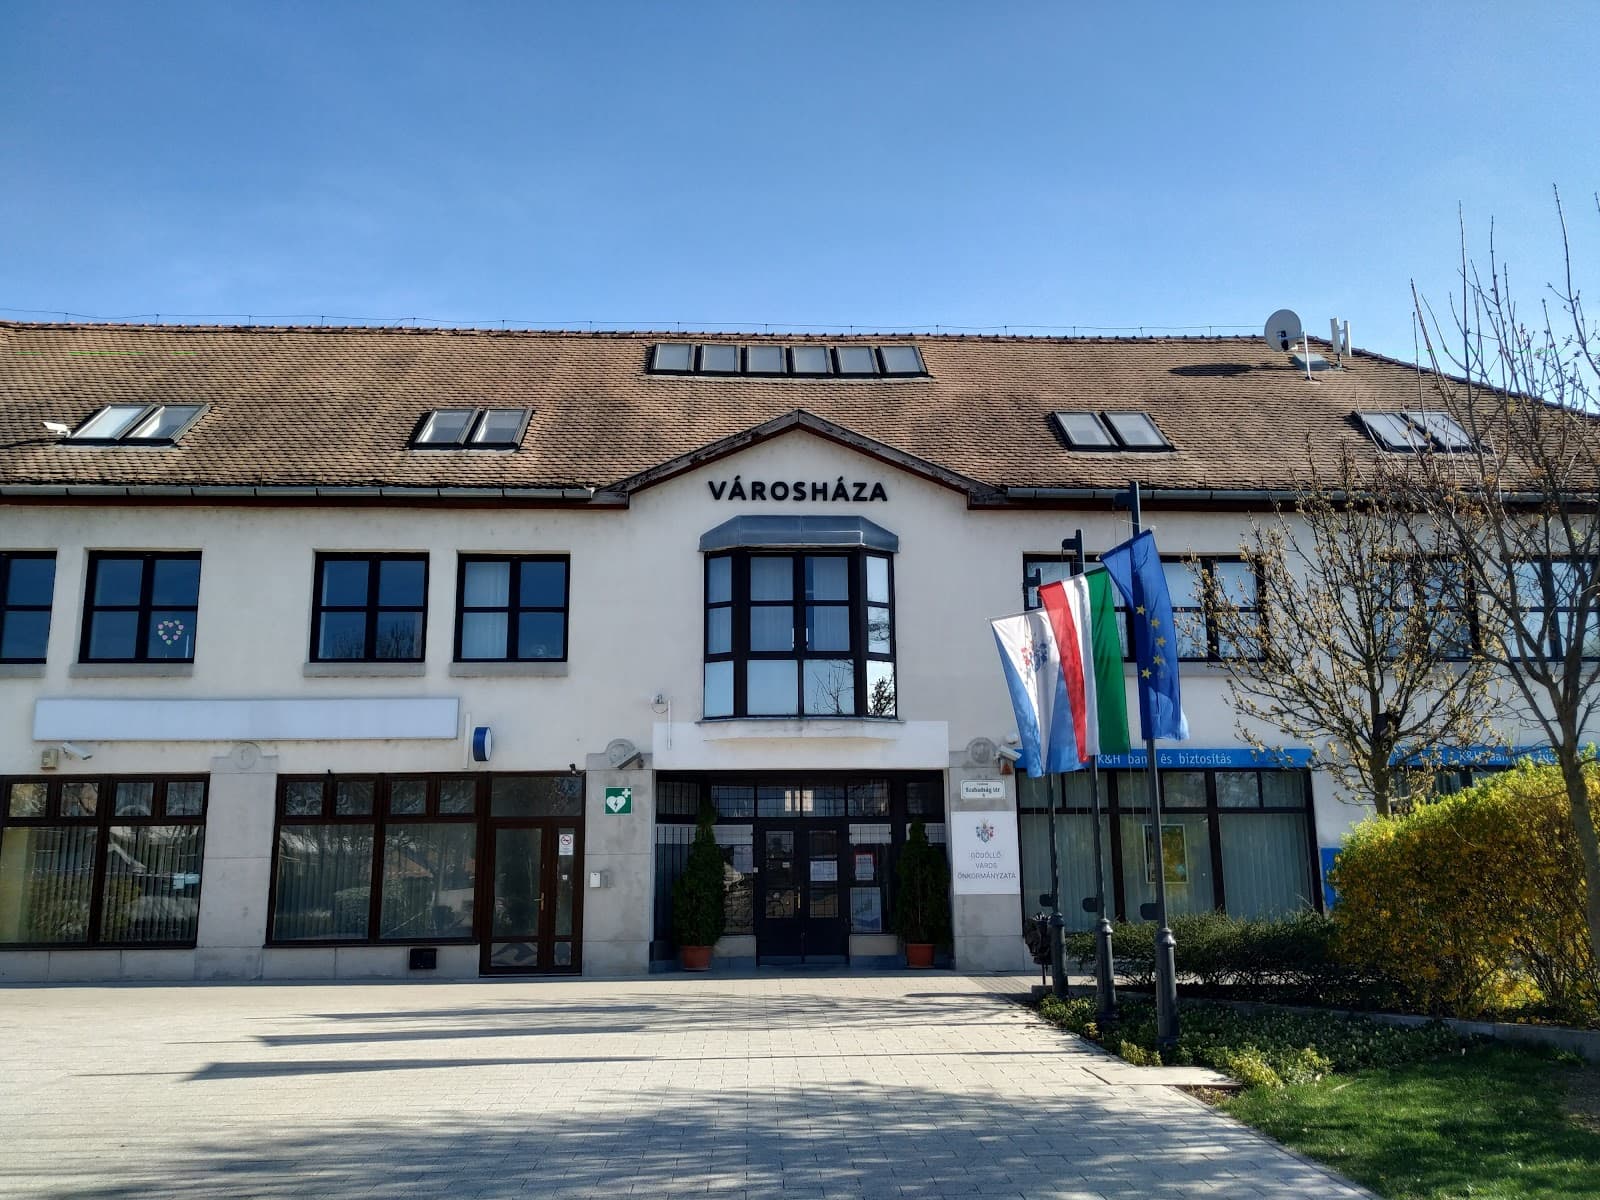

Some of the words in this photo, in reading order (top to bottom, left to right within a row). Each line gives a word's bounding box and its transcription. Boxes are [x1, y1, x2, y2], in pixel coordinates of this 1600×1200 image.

[708, 475, 888, 502] VÁROSHÁZA
[1097, 754, 1121, 764] K&H
[1128, 754, 1148, 765] ban
[1160, 754, 1172, 764] és
[1179, 753, 1232, 765] biztosítás
